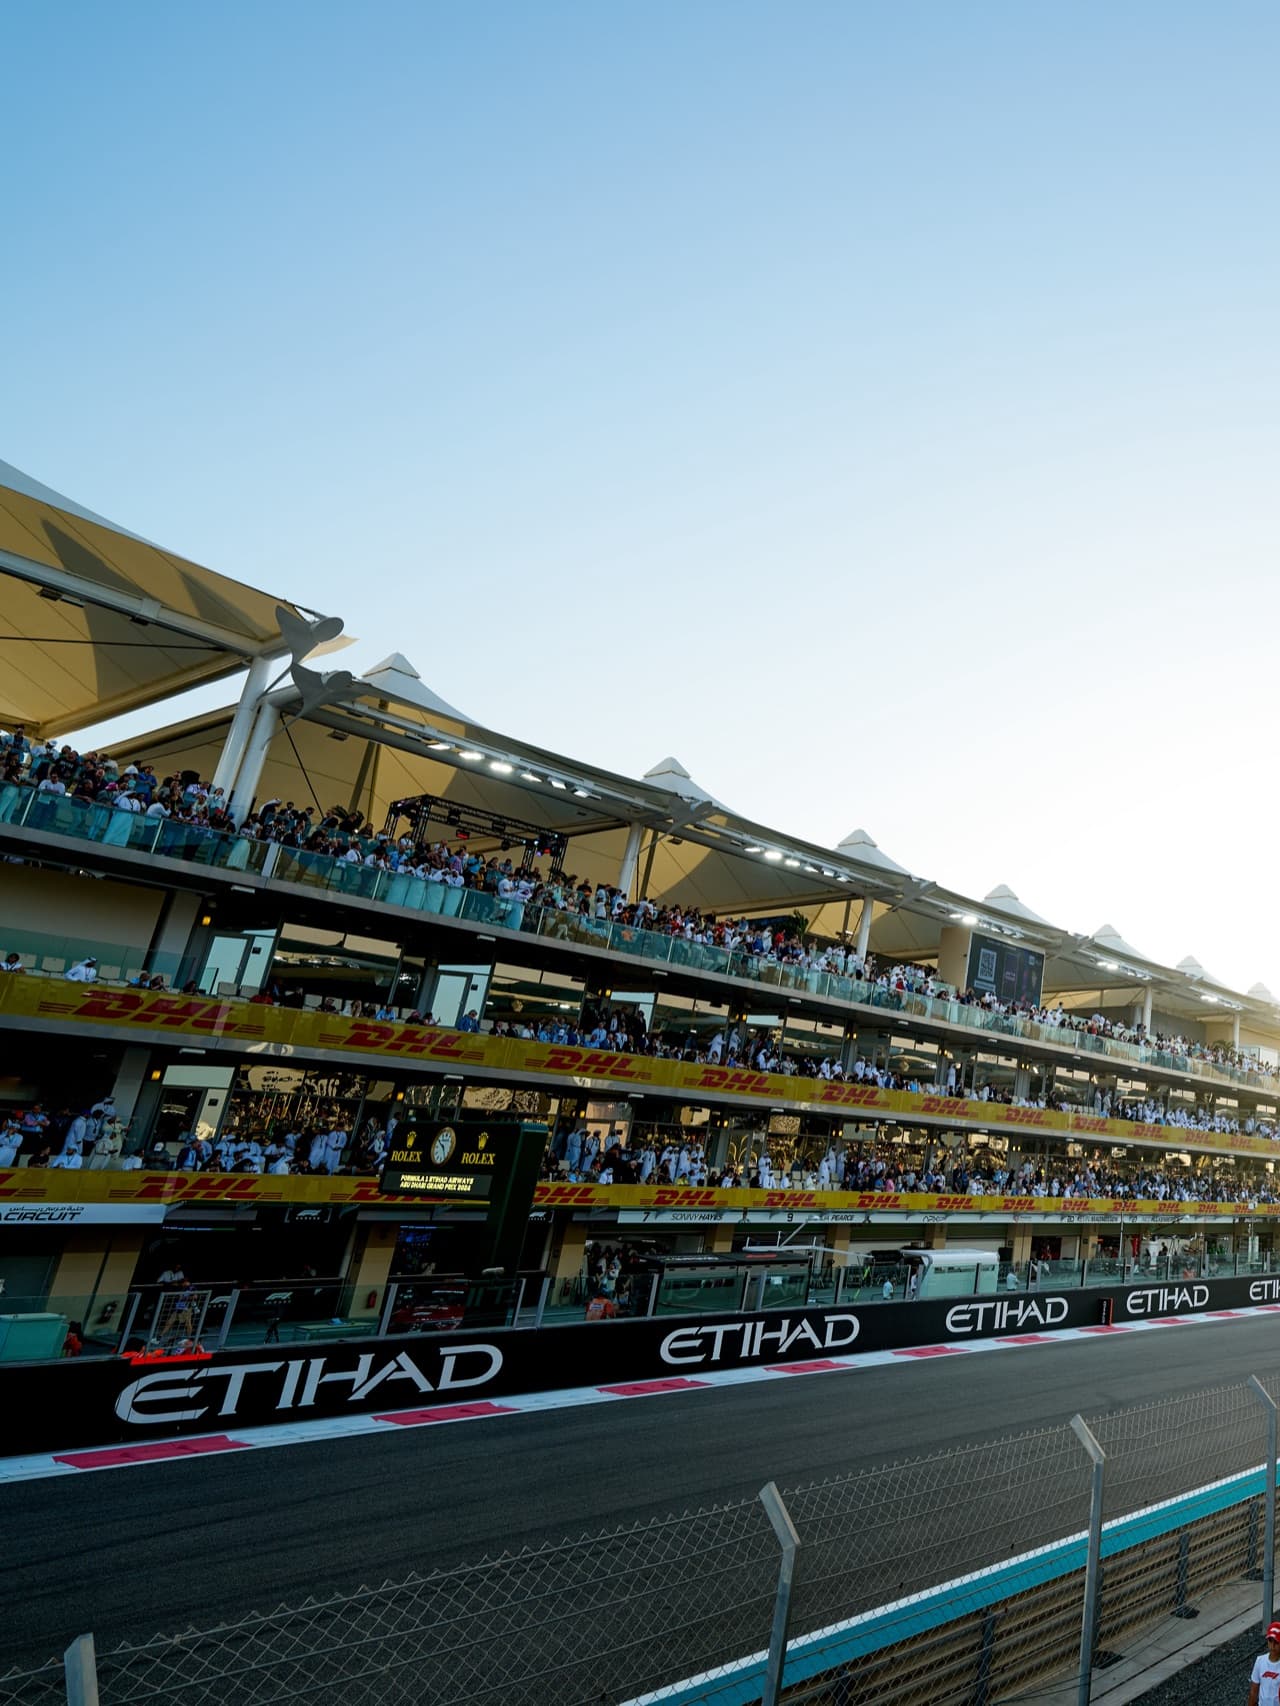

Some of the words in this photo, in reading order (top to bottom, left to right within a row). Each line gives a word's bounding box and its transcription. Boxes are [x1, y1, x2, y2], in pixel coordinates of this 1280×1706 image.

[73, 990, 236, 1032] DHL
[343, 1024, 463, 1058] DHL
[543, 1049, 639, 1076] DHL
[698, 1069, 771, 1093] DHL
[820, 1084, 882, 1105] DHL
[921, 1097, 970, 1116] DHL
[1004, 1107, 1045, 1124] DHL
[1074, 1116, 1109, 1132] DHL
[1133, 1124, 1164, 1138] DHL
[390, 1150, 422, 1163] ROLEX
[461, 1152, 496, 1166] ROLEX
[134, 1175, 259, 1200] DHL
[400, 1174, 425, 1183] FORMULA
[448, 1177, 475, 1185] AIRWAYS
[652, 1189, 717, 1207] DHL
[763, 1191, 817, 1208] DHL
[853, 1194, 901, 1208] DHL
[936, 1196, 973, 1210] DHL
[1003, 1198, 1035, 1211] DHL
[1062, 1199, 1089, 1211] DHL
[1112, 1200, 1138, 1212] DHL
[1158, 1202, 1180, 1213] DHL
[4, 1212, 82, 1222] CIRCUIT
[643, 1212, 651, 1223] 7
[786, 1213, 793, 1222] 9
[1126, 1285, 1210, 1314] ETIHAD
[945, 1297, 1069, 1333] ETIHAD
[659, 1314, 860, 1364] ETIHAD
[116, 1345, 503, 1424] ETIHAD
